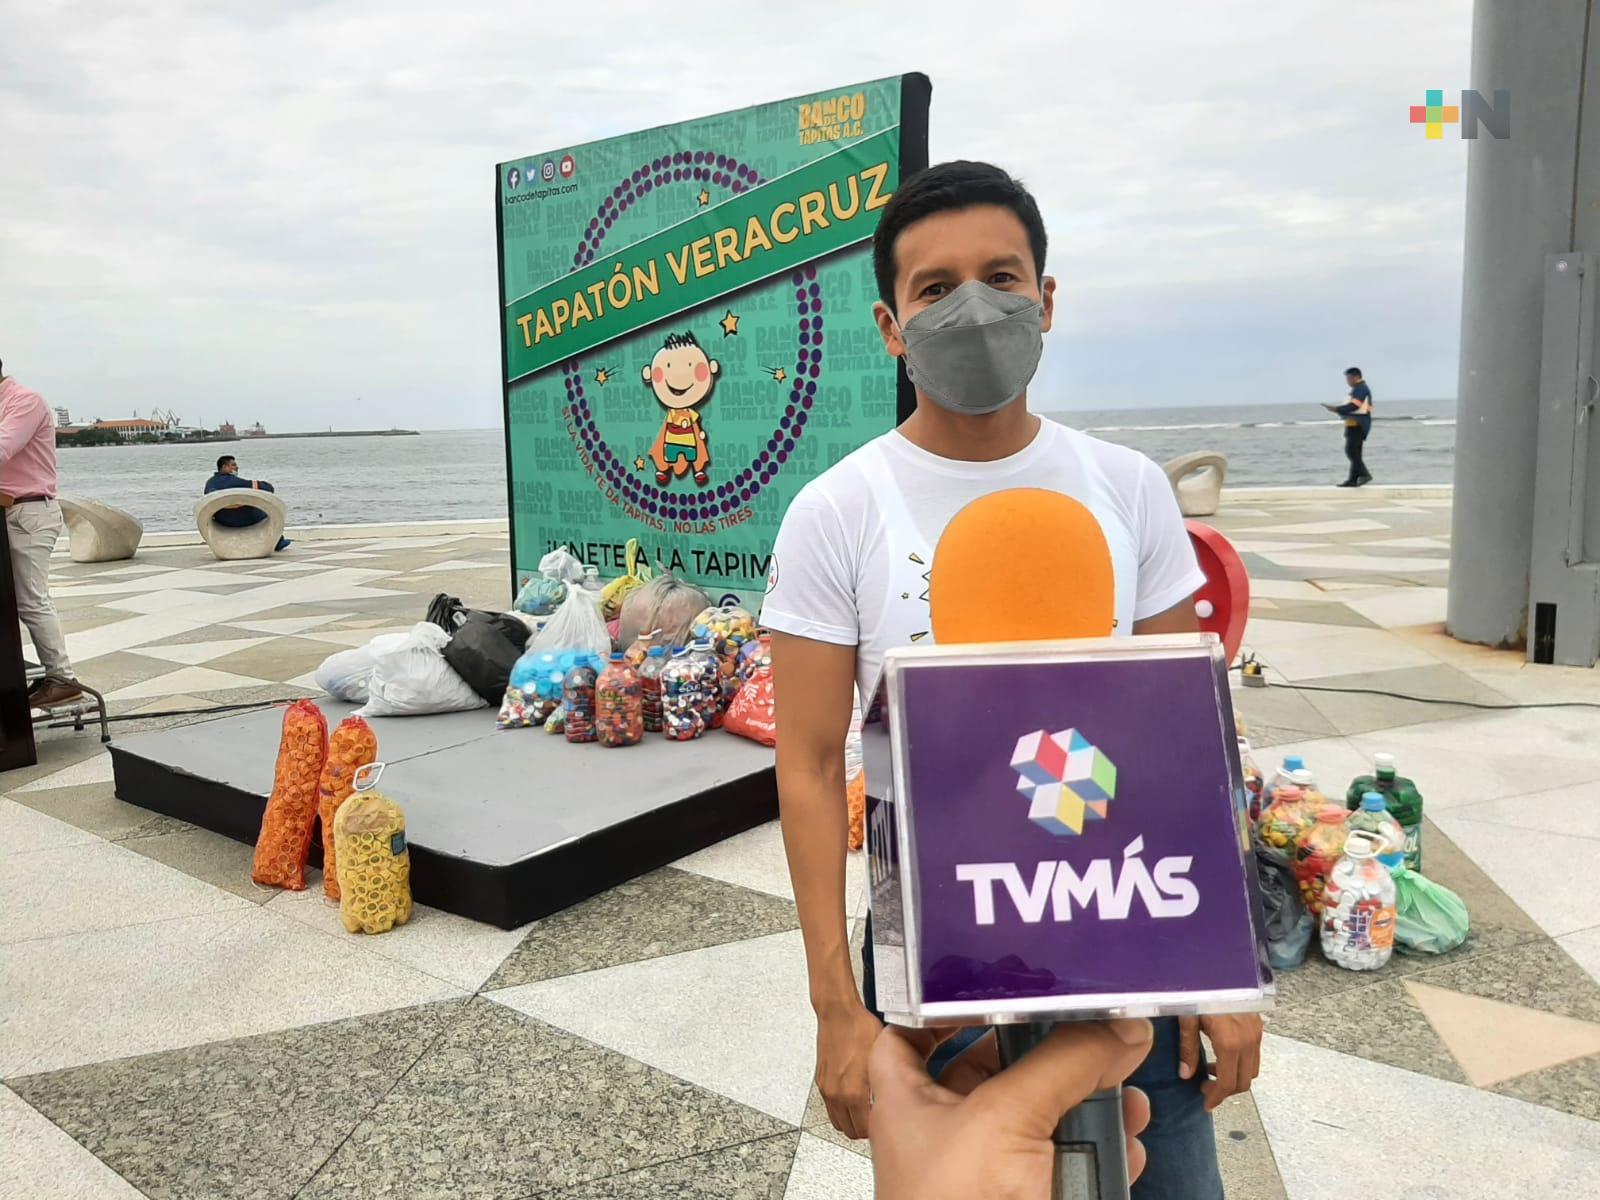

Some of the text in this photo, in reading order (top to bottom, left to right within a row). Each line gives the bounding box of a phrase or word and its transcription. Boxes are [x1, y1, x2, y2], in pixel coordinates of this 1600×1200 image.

[800, 92, 865, 130] BANCO
[800, 120, 864, 146] TAPITAS A.C.
[504, 184, 578, 205] bancodetapitas.com
[516, 261, 660, 348] TAPATÓN
[664, 162, 893, 286] VERACRUZ
[576, 441, 595, 476] VIDA
[594, 473, 607, 490] TE
[606, 487, 620, 506] DA
[622, 501, 667, 533] TAPITAS,
[673, 521, 692, 534] NO
[695, 522, 717, 534] LAS
[718, 505, 754, 530] TIRES
